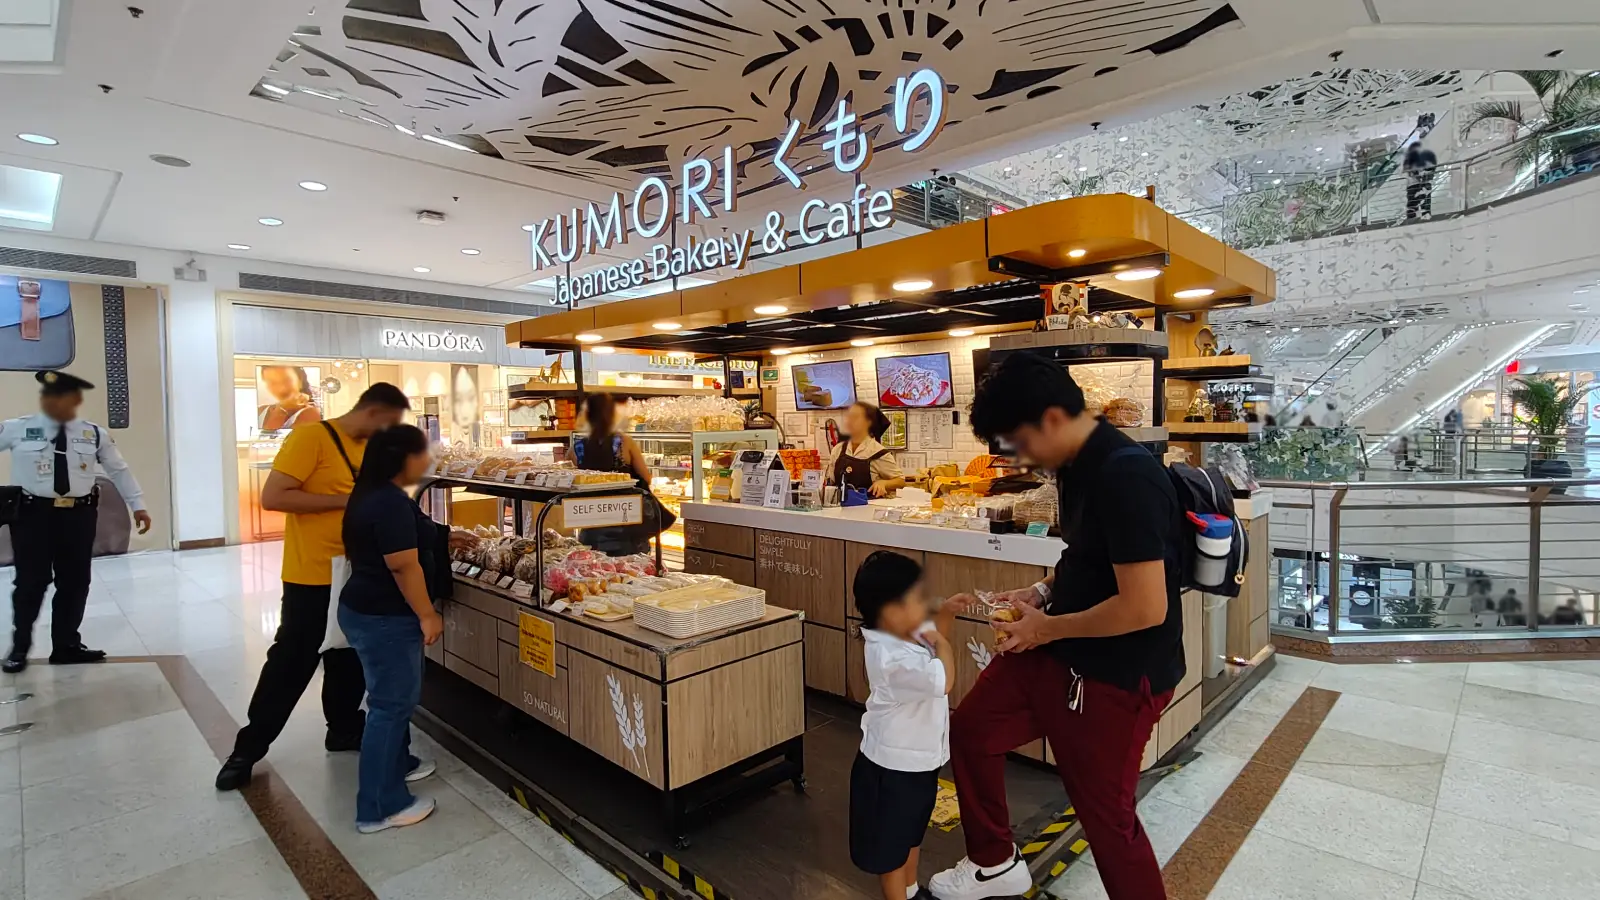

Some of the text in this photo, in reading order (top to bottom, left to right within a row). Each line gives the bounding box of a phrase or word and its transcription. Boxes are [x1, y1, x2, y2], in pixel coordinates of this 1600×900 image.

[530, 68, 945, 270] KUMORI くもり
[548, 183, 893, 306] Japanese Bakery & Cafe
[385, 329, 484, 351] PANDORA
[573, 502, 633, 515] SELF SERVICE
[759, 534, 812, 550] DELIGHTFULLY
[759, 545, 784, 558] SIMPLE
[523, 691, 566, 724] SO NATURAL
